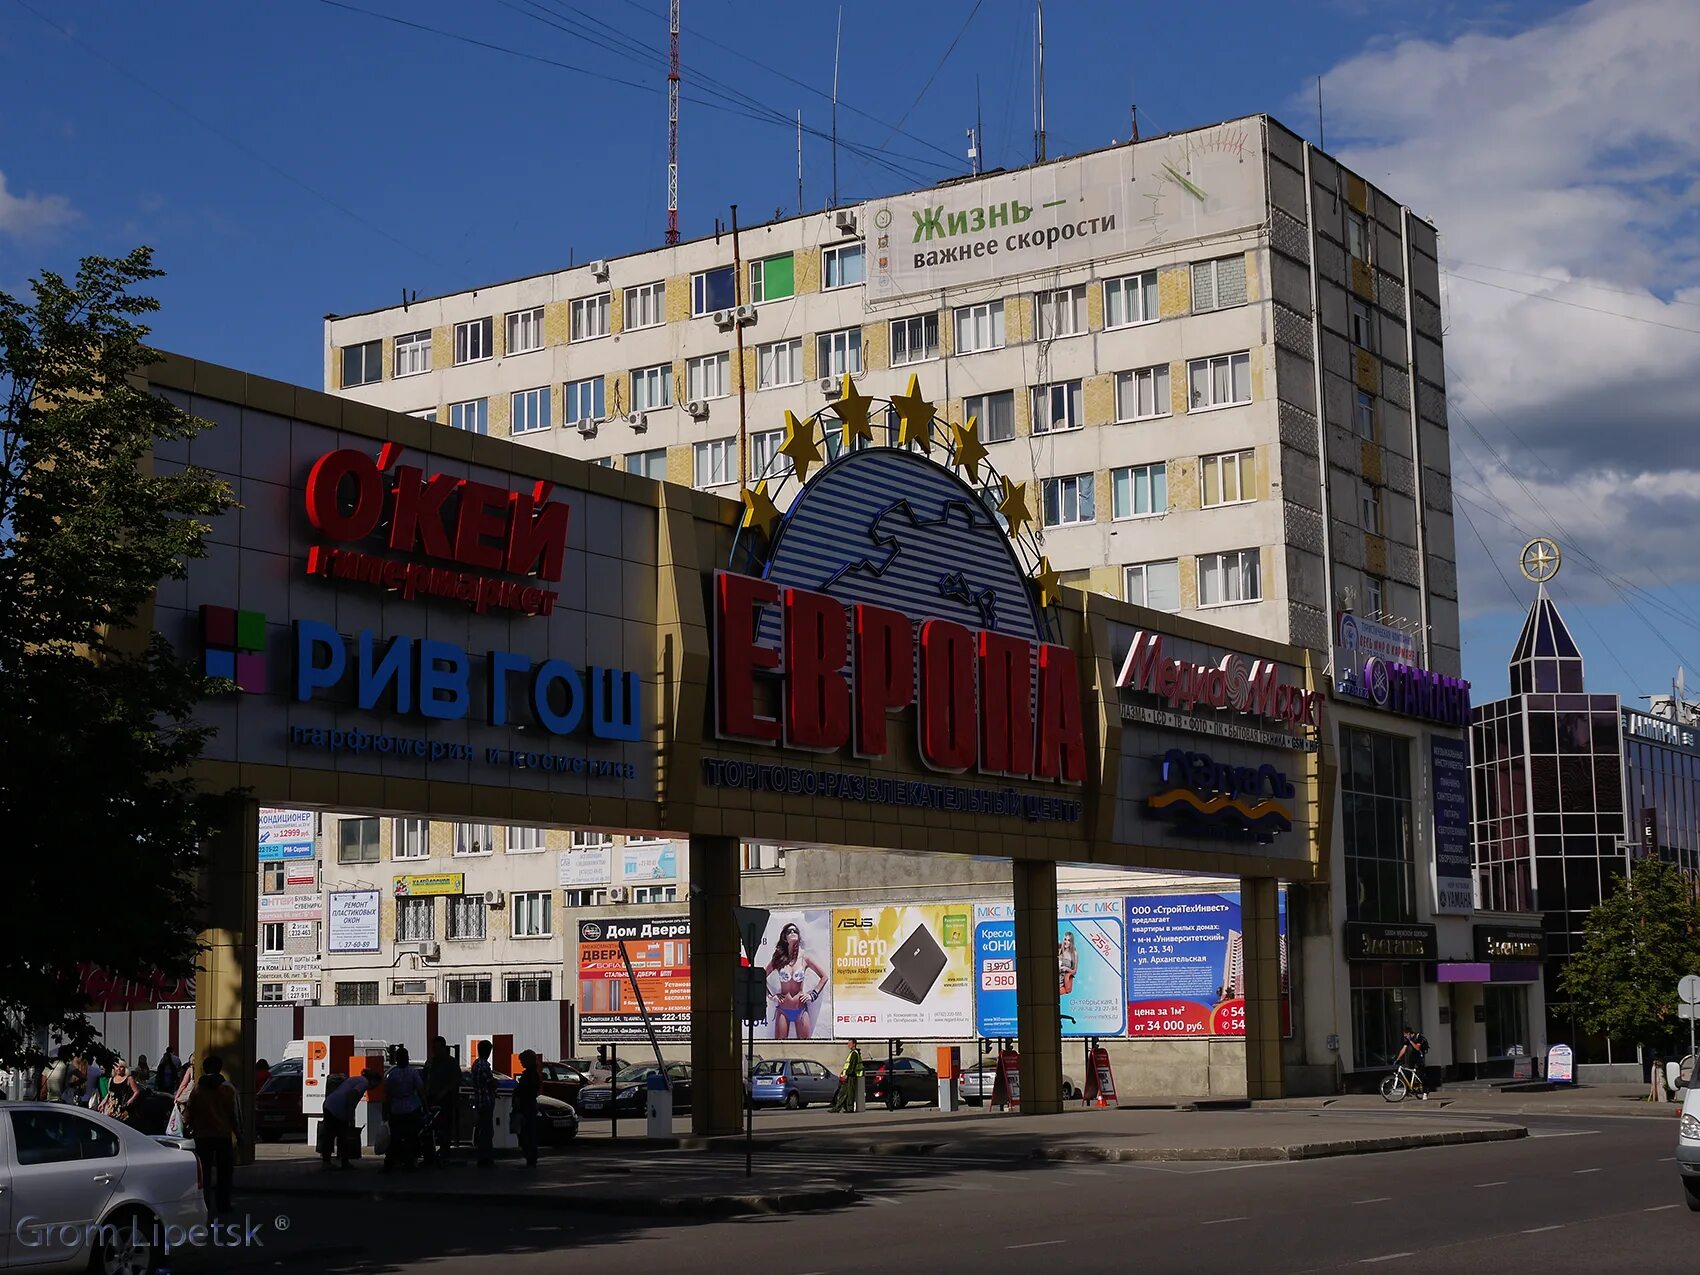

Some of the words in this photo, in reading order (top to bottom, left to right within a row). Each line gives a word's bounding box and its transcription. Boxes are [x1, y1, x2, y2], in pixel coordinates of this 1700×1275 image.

[912, 199, 1032, 244] Жизнь
[913, 239, 998, 269] важнее
[1006, 213, 1116, 250] скорости
[305, 440, 569, 582] О'КЕЙ
[306, 545, 559, 616] гипермаркет
[292, 619, 471, 720] РИВ
[487, 650, 641, 742] ГОШ
[713, 568, 1086, 787] ЕВРОПА
[1153, 711, 1167, 726] LCD
[1174, 714, 1183, 728] ТВ
[1189, 716, 1208, 733] ФОТО
[1214, 720, 1224, 736] ПК
[1228, 723, 1258, 743] БЫТОВАЯ
[1259, 730, 1287, 748] ТЕХНИКА
[1291, 736, 1306, 751] GSM
[290, 725, 473, 763] парфюмерия
[485, 747, 501, 765] и
[510, 751, 636, 782] косметика
[702, 757, 1020, 817] ТОРГОВО-РАЗВЛЕКАТЕЛЬНЫЙ
[1021, 792, 1084, 824] ЦЕНТР
[259, 812, 311, 825] КОНДИЦИОНЕР
[279, 829, 301, 838] 12999
[344, 901, 369, 909] РЕМОНТ
[1447, 890, 1472, 909] YAMAHA
[978, 906, 1001, 917] МКС
[1065, 903, 1089, 914] МКС
[1095, 902, 1119, 912] МКС
[1131, 906, 1151, 914] ООО
[1153, 903, 1230, 915] «СтройТехИнвест»
[332, 909, 377, 917] ПЛАСТИКОВЫХ
[837, 918, 873, 928] ASUS
[1131, 917, 1170, 925] предлагает
[606, 925, 637, 939] Дом
[1132, 926, 1164, 934] квартиры
[1196, 924, 1219, 932] домах:
[982, 930, 1013, 940] Кресло
[1137, 936, 1151, 944] м-н
[1152, 933, 1225, 944] «Университетский»
[845, 935, 887, 957] Лето
[1089, 932, 1112, 957] -25%
[1137, 945, 1149, 955] (д.
[1149, 945, 1160, 954] 23,
[1161, 945, 1174, 955] 34)
[582, 950, 624, 962] ДВЕРИ
[1138, 957, 1149, 966] ул.
[1150, 955, 1207, 965] Архангельская
[837, 957, 872, 969] солнце
[837, 967, 857, 976] Ноутбуки
[858, 967, 869, 976] ASUS
[995, 975, 1015, 986] 980
[1134, 1008, 1155, 1017] цена
[1231, 1006, 1245, 1016] 54
[662, 1013, 691, 1021] 222-155
[662, 1025, 691, 1033] 221-420
[1134, 1023, 1145, 1031] от
[1147, 1020, 1160, 1031] 34
[1163, 1020, 1184, 1031] 000
[1186, 1022, 1205, 1032] руб.
[1231, 1019, 1245, 1030] 54
